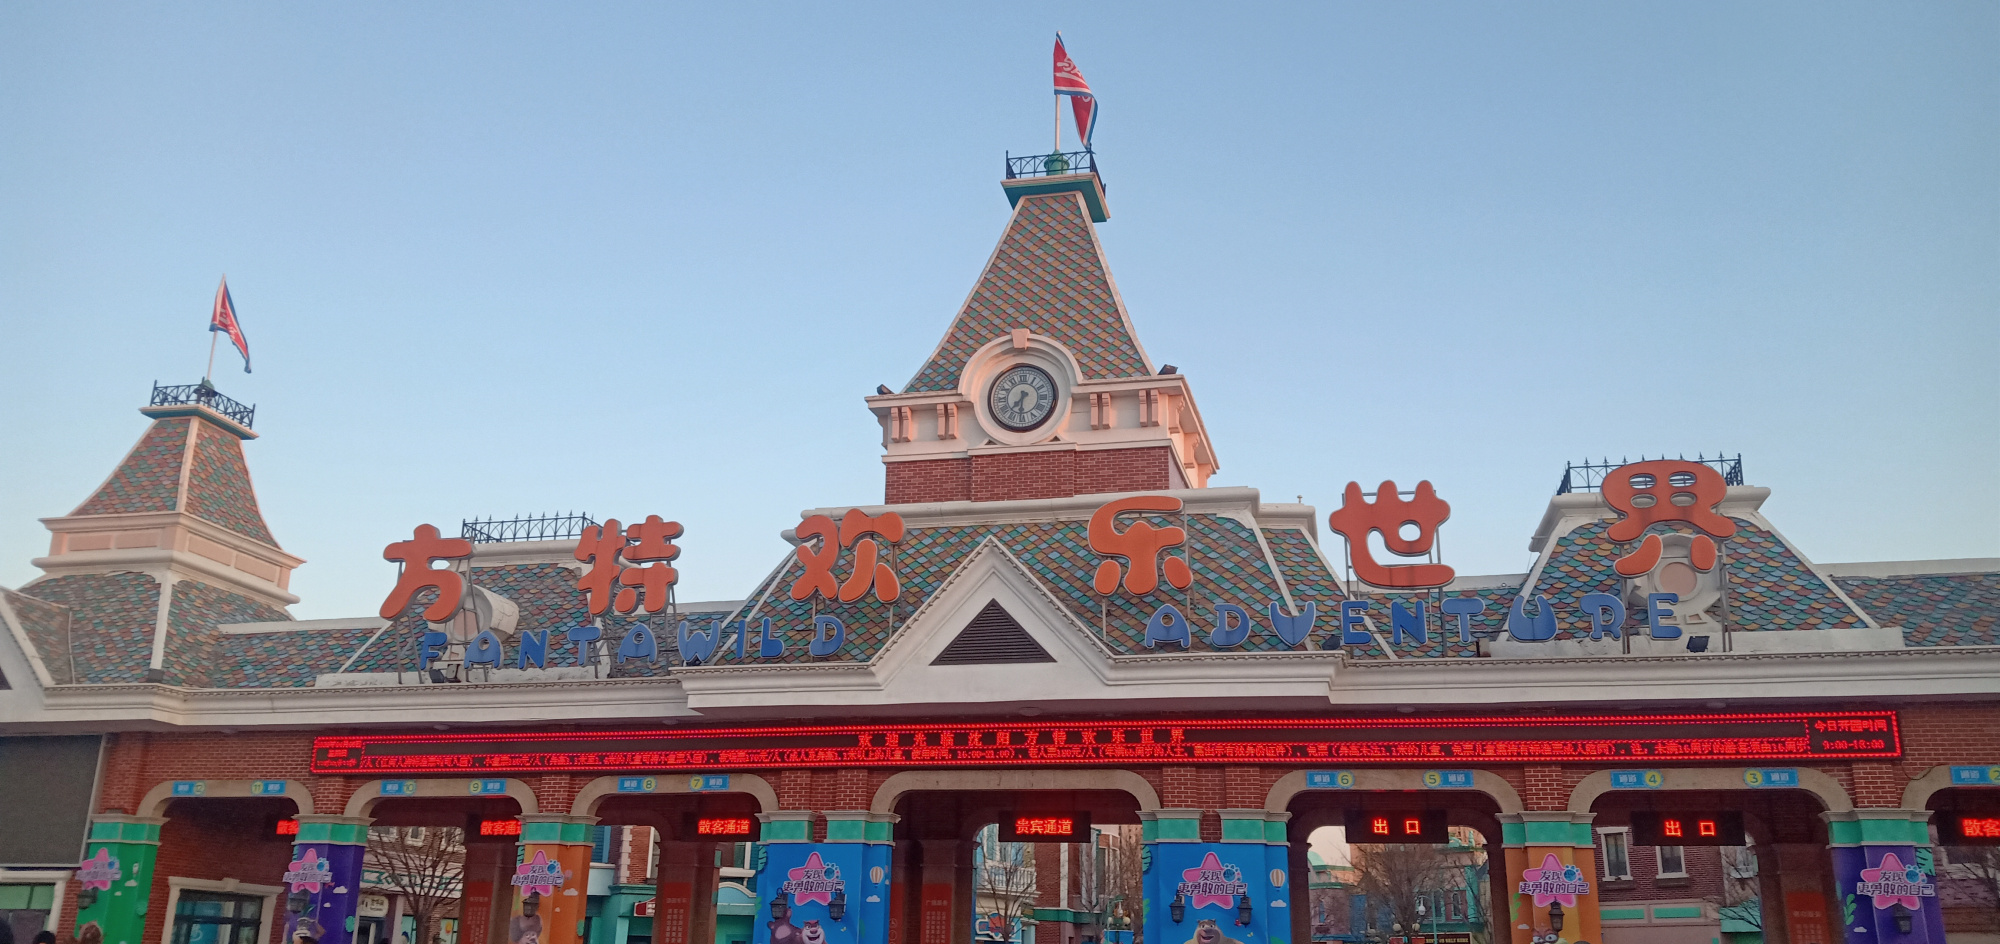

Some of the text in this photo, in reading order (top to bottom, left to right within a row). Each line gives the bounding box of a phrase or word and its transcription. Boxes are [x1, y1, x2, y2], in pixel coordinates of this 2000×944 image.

[420, 592, 1684, 671] FANTAWILD ADVENTURE
[1814, 719, 1888, 733] 今日开园时间
[857, 728, 1185, 749] 欢迎光临沈阳方特欢乐世界
[698, 819, 750, 835] 散客通道
[1015, 818, 1073, 835] 贵宾通道
[1373, 818, 1420, 835] 出口
[1665, 820, 1716, 837] 出口
[1199, 870, 1222, 881] 发现
[1541, 871, 1562, 881] 发现
[1879, 871, 1904, 882] 发现
[1178, 882, 1247, 895] 更勇敢的自己
[1520, 882, 1589, 894] 更勇敢的自己
[1858, 882, 1934, 896] 更勇敢的自己
